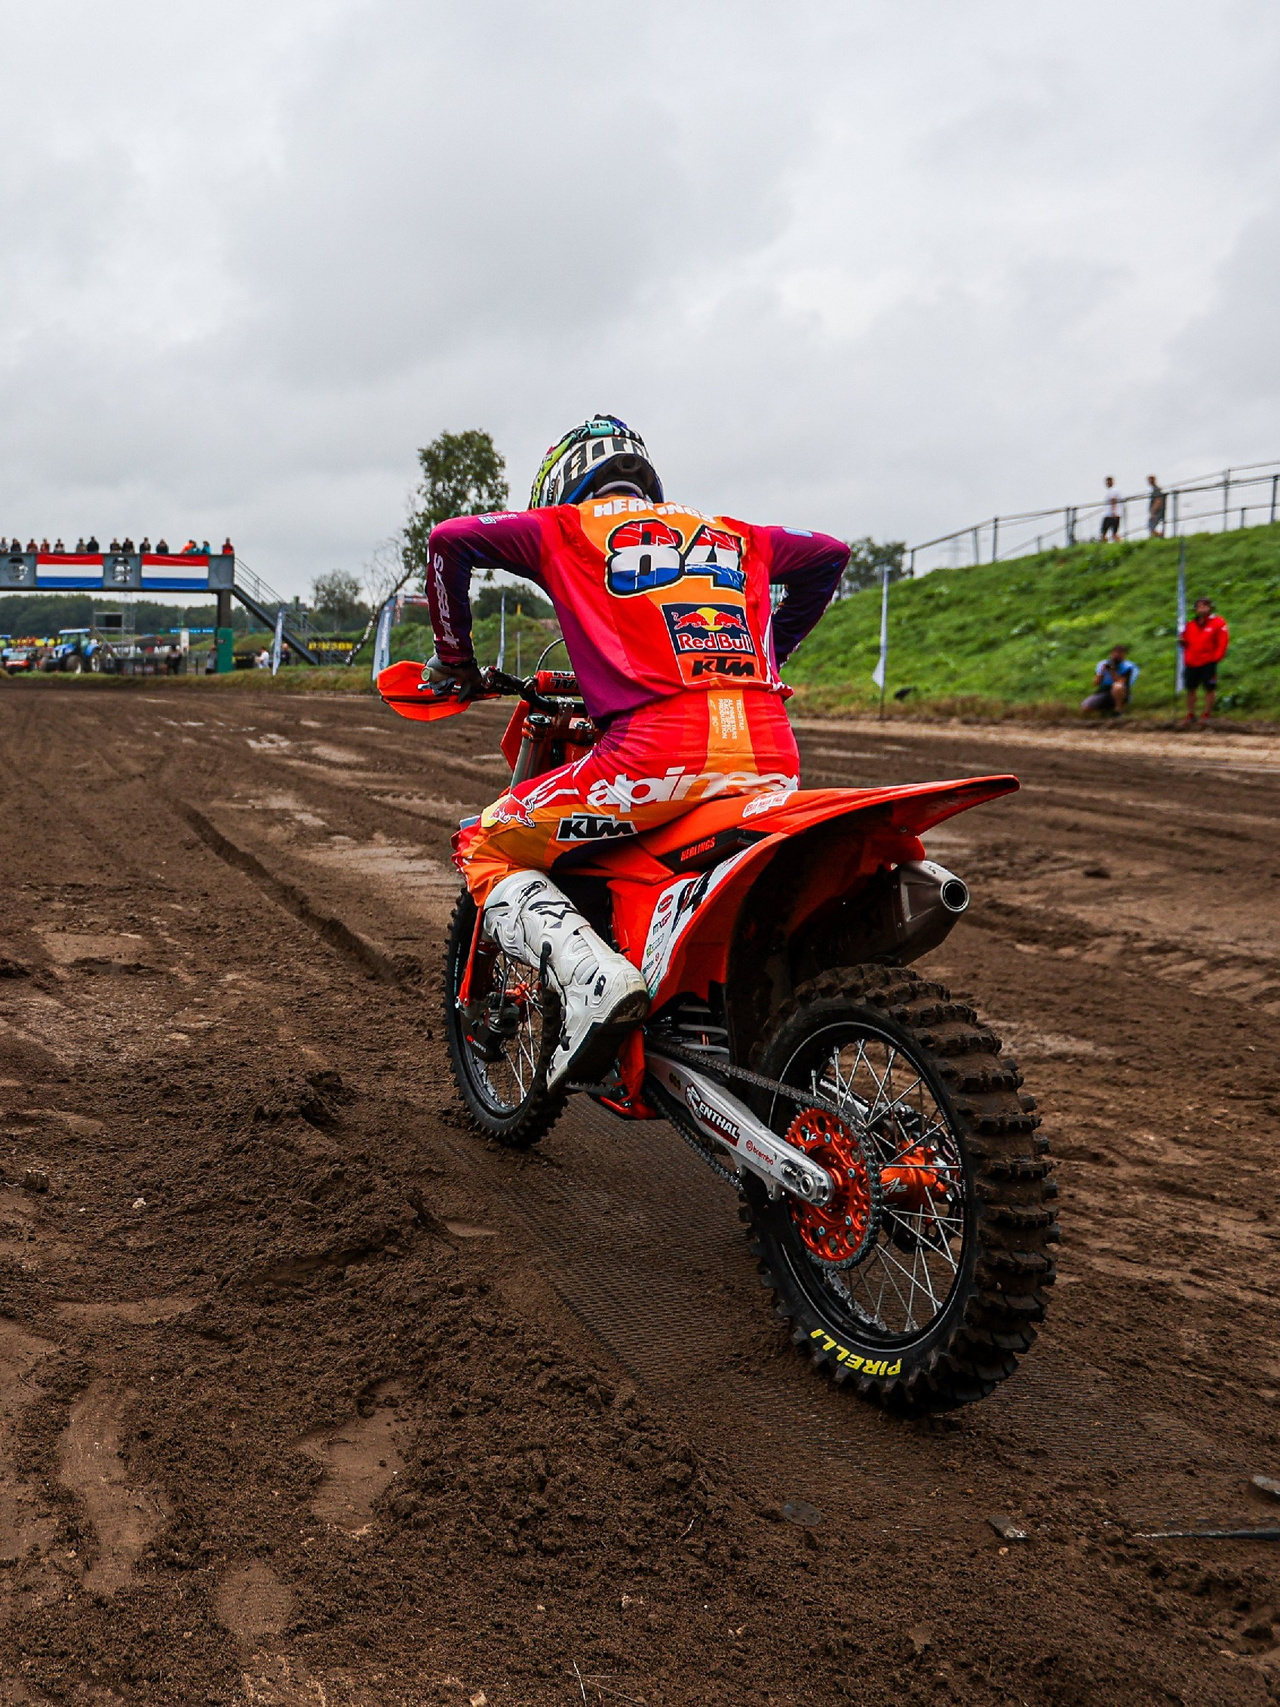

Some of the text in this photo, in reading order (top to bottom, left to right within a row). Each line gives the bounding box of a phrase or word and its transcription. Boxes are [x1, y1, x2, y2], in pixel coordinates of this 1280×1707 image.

[605, 517, 748, 598] 84
[677, 633, 753, 653] Red Bull
[691, 655, 756, 677] KTM
[559, 812, 636, 841] KTM
[680, 835, 717, 862] HERLINGS
[753, 1145, 775, 1166] brembo
[810, 1328, 903, 1376] PIRELLI
